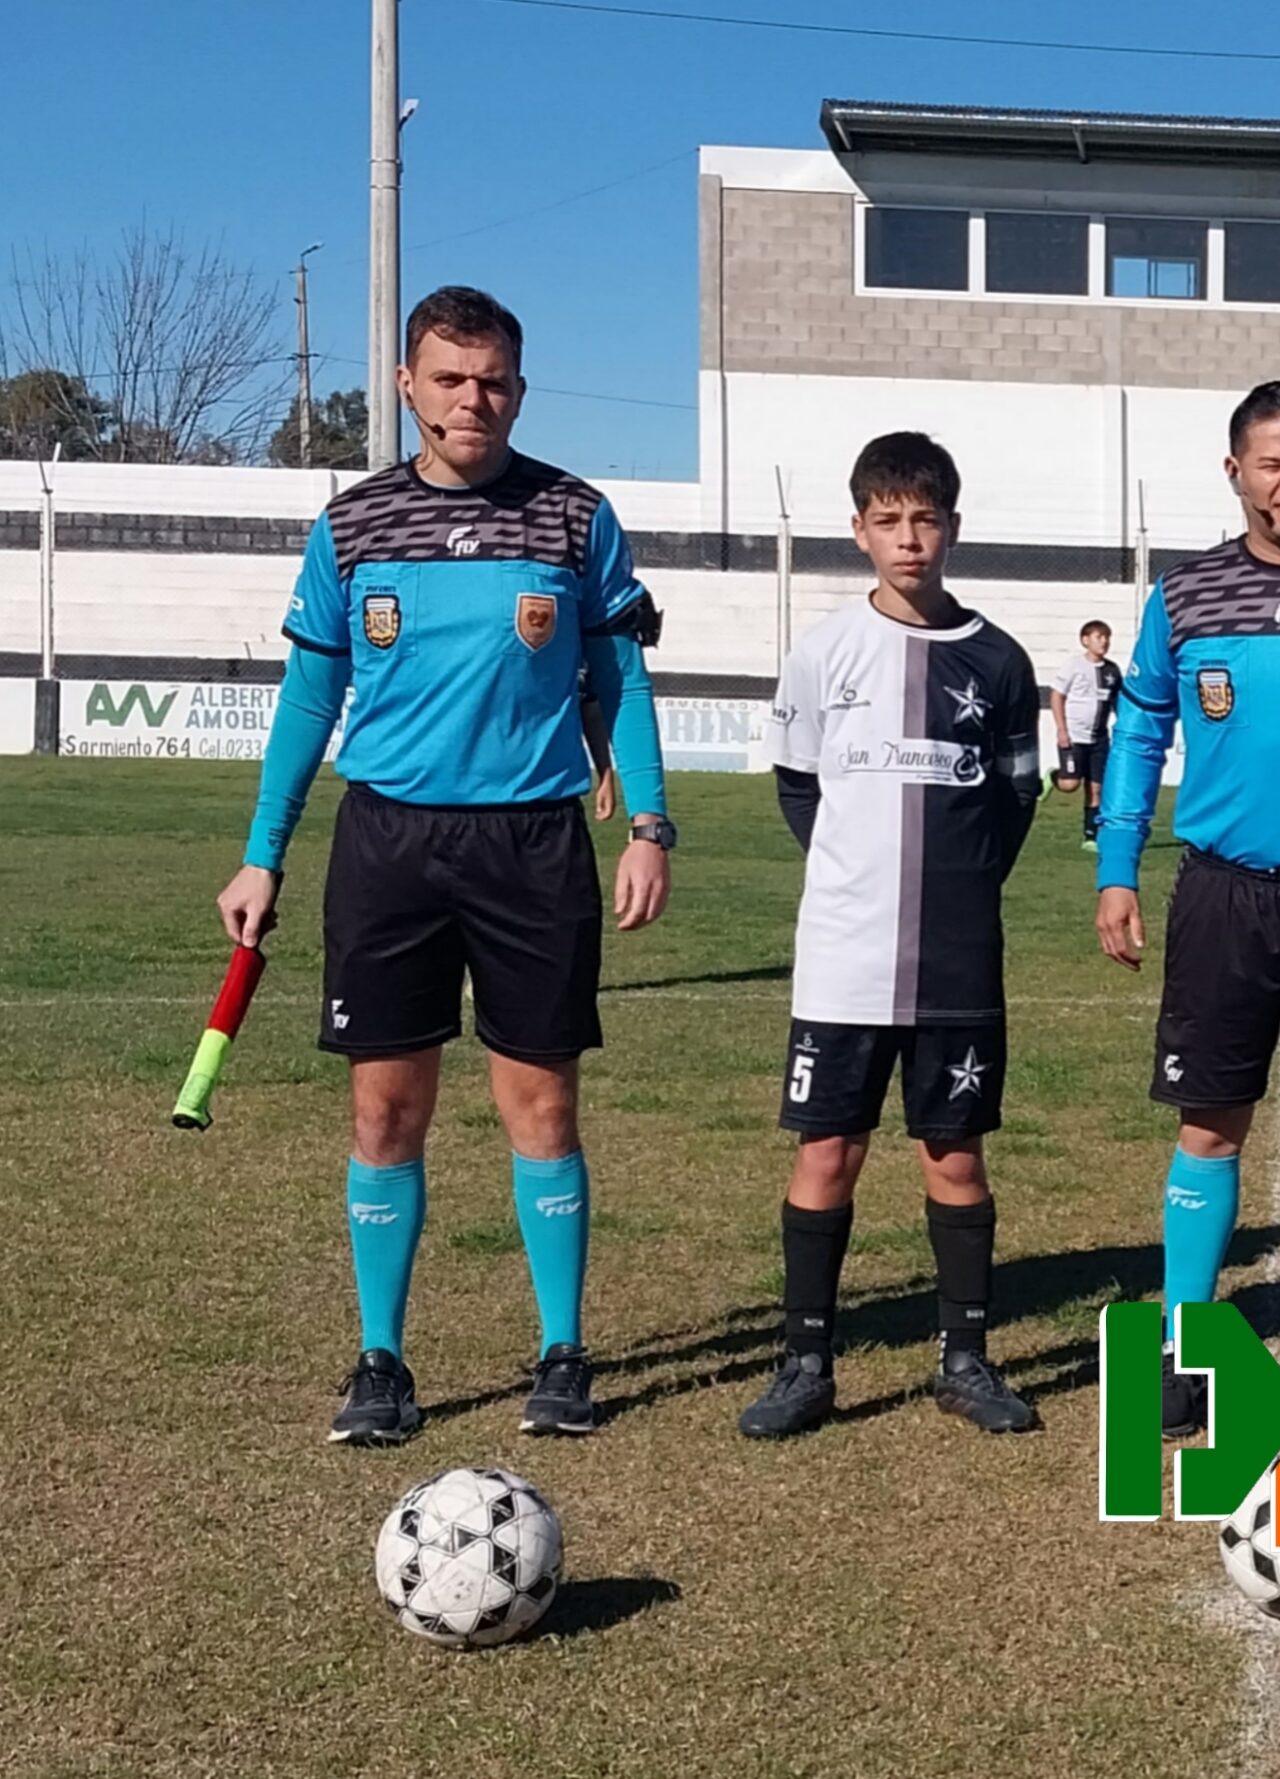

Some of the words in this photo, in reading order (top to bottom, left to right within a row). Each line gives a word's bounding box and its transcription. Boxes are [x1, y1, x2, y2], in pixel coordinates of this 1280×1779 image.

[64, 735, 152, 756] Sarmiento
[155, 736, 190, 758] 764
[789, 1054, 815, 1103] 5
